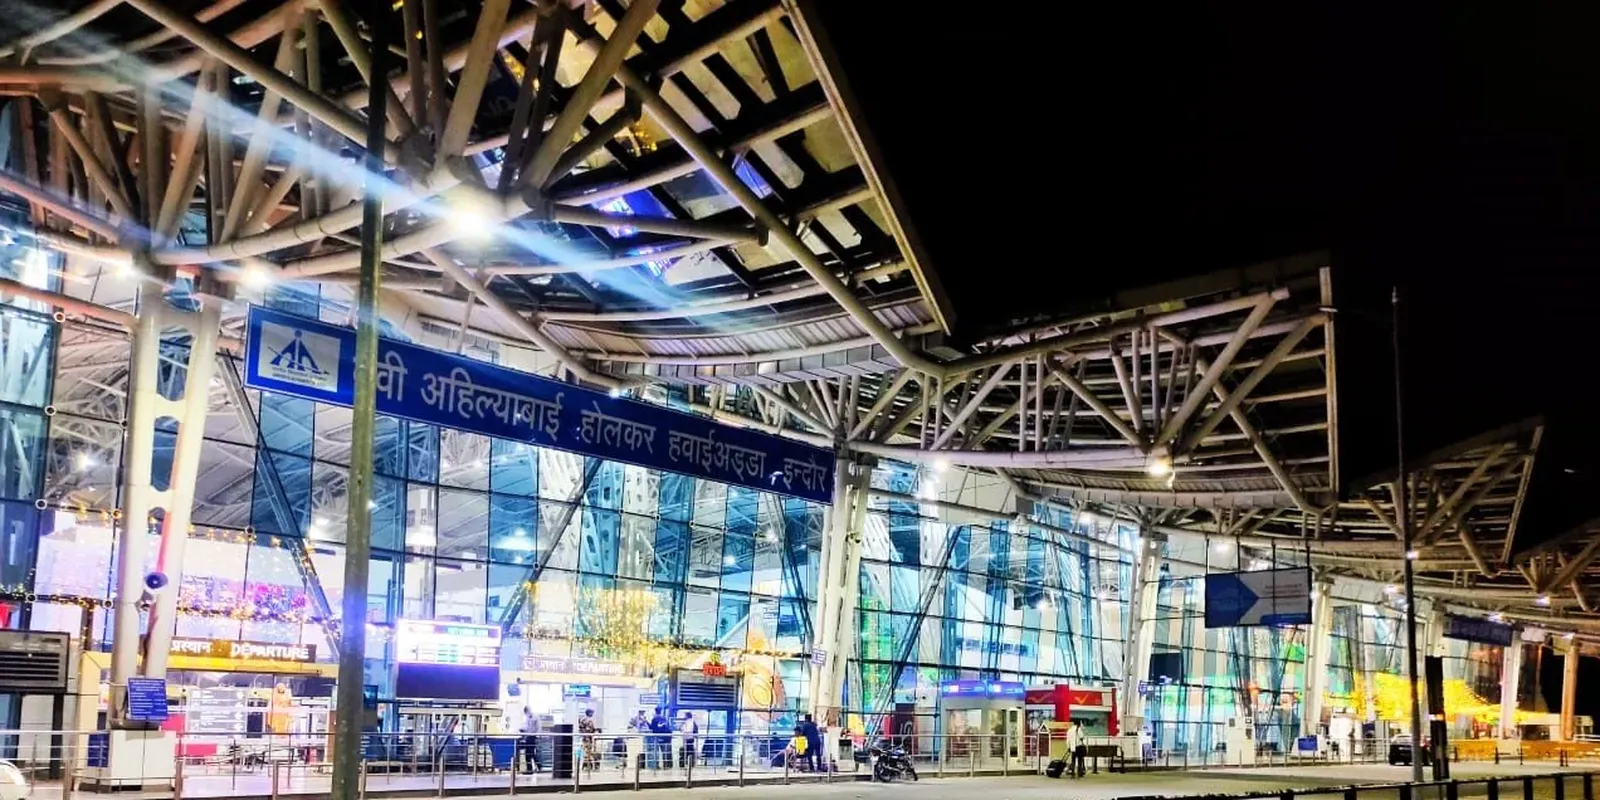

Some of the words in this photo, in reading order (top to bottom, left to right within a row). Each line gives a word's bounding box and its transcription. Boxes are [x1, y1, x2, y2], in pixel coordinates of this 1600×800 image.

[420, 366, 565, 442] अहिल्याबाई
[580, 400, 657, 453] होलकर
[783, 453, 828, 492] इन्दौर
[231, 641, 309, 660] DEPARTURE
